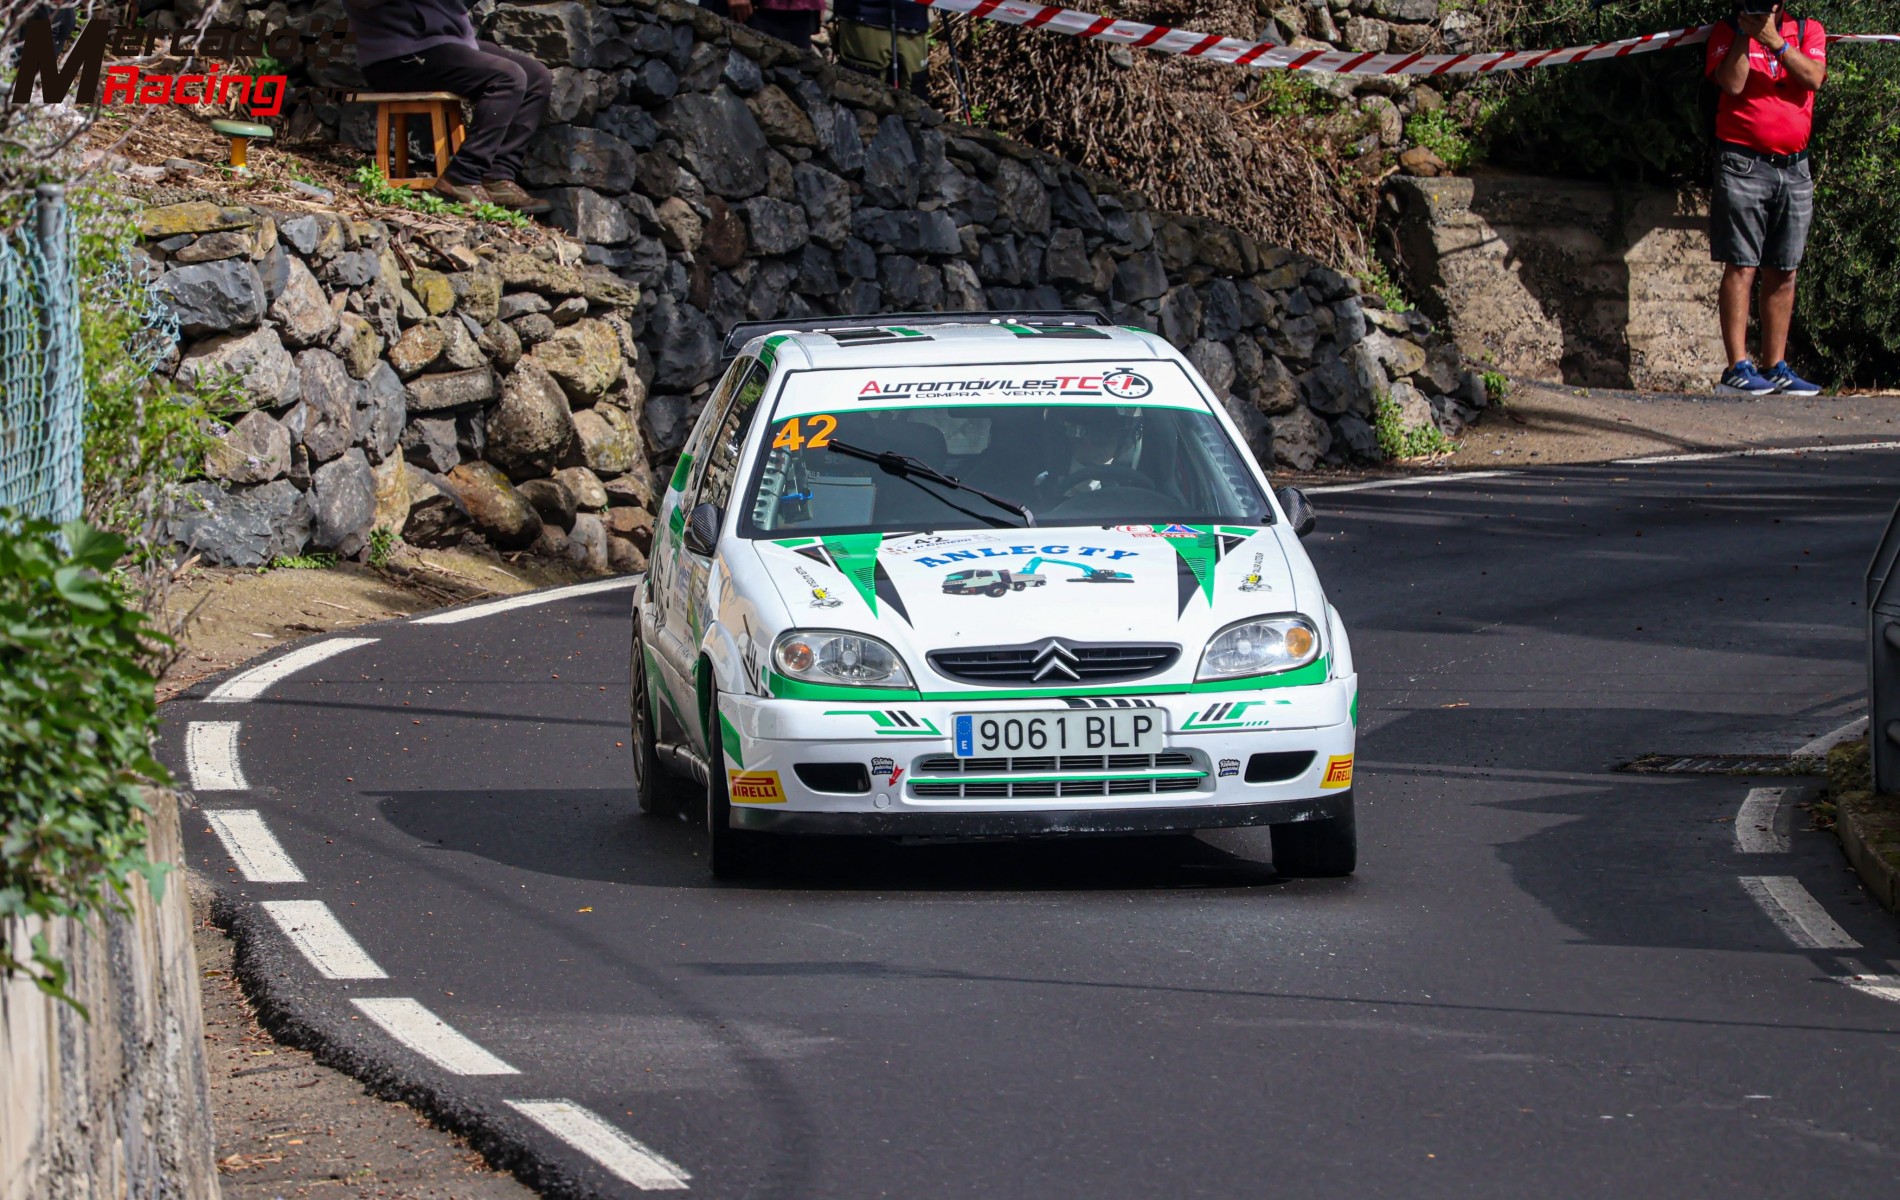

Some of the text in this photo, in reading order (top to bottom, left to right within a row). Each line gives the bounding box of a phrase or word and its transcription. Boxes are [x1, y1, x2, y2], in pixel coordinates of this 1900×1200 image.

[915, 391, 981, 399] COMPRA
[772, 414, 838, 451] 42
[914, 536, 948, 545] 42
[913, 545, 1139, 568] ANLEGTY
[980, 715, 1153, 751] 9061 BLP
[961, 740, 968, 750] E
[731, 775, 778, 797] PIRELLI
